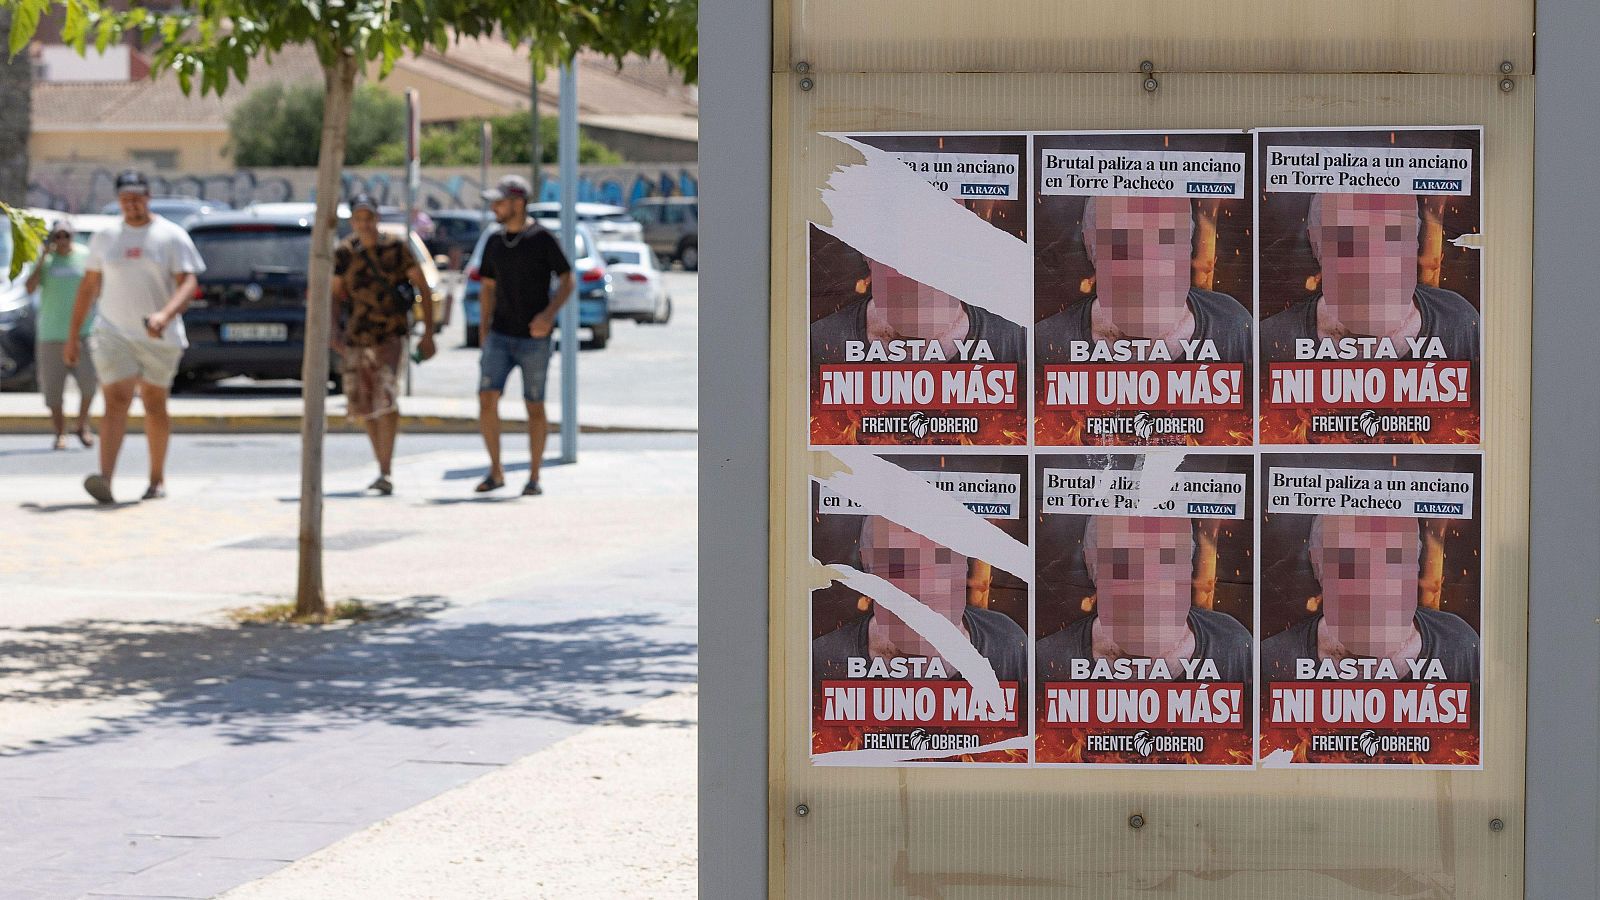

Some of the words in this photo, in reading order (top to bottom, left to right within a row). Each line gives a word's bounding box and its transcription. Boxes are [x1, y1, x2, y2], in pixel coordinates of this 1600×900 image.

[921, 162, 929, 172] a
[934, 162, 952, 172] un
[956, 160, 1014, 174] anciano
[1046, 154, 1094, 170] Brutal
[1098, 156, 1142, 174] paliza
[1146, 162, 1154, 172] a
[1160, 161, 1178, 172] un
[1182, 158, 1241, 173] anciano
[1270, 152, 1320, 167] Brutal
[1324, 154, 1368, 170] paliza
[1372, 159, 1381, 168] a
[1385, 158, 1404, 168] un
[1409, 155, 1468, 170] anciano
[1045, 177, 1063, 188] en
[1066, 174, 1108, 189] Torre
[1113, 175, 1174, 191] Pacheco
[1270, 174, 1288, 185] en
[1292, 172, 1334, 186] Torre
[1338, 172, 1400, 187] Pacheco
[846, 340, 946, 362] BASTA
[953, 340, 994, 361] YA
[1070, 340, 1171, 362] BASTA
[1180, 340, 1221, 360] YA
[1296, 337, 1398, 360] BASTA
[1406, 336, 1447, 359] YA
[822, 371, 864, 405] ¡NI
[871, 370, 934, 405] UNO
[942, 364, 1015, 405] MÁS!
[1046, 371, 1088, 405] ¡NI
[1096, 370, 1160, 405] UNO
[1167, 364, 1241, 404] MÁS!
[1272, 369, 1314, 403] ¡NI
[1321, 368, 1386, 403] UNO
[1394, 362, 1468, 403] MÁS!
[862, 417, 908, 433] FRENTE
[930, 417, 978, 433] OBRERO
[1087, 418, 1132, 434] FRENTE
[1155, 418, 1203, 433] OBRERO
[1312, 416, 1358, 432] FRENTE
[1382, 416, 1430, 432] OBRERO
[959, 479, 1016, 493] anciano
[1048, 474, 1095, 489] Brutal
[1184, 479, 1241, 493] anciano
[1273, 473, 1321, 488] Brutal
[1325, 476, 1369, 492] paliza
[1374, 481, 1382, 490] a
[1387, 480, 1406, 490] un
[1410, 478, 1469, 493] anciano
[824, 496, 840, 506] en
[1047, 496, 1064, 506] en
[1272, 496, 1290, 506] en
[1294, 493, 1336, 507] Torre
[1340, 494, 1401, 510] Pacheco
[847, 657, 947, 678] BASTA
[1071, 658, 1172, 680] BASTA
[1180, 658, 1221, 680] YA
[1296, 658, 1398, 680] BASTA
[1406, 658, 1447, 680] YA
[824, 688, 865, 721] ¡NI
[873, 687, 936, 721] UNO
[1048, 689, 1088, 722] ¡NI
[1096, 688, 1160, 723] UNO
[1167, 683, 1240, 723] MÁS!
[1272, 689, 1314, 722] ¡NI
[1321, 688, 1386, 723] UNO
[1394, 683, 1468, 723] MÁS!
[864, 734, 909, 749] FRENTE
[932, 734, 979, 750] OBRERO
[1087, 736, 1132, 752] FRENTE
[1155, 736, 1204, 752] OBRERO
[1312, 736, 1358, 752] FRENTE
[1382, 736, 1430, 752] OBRERO
